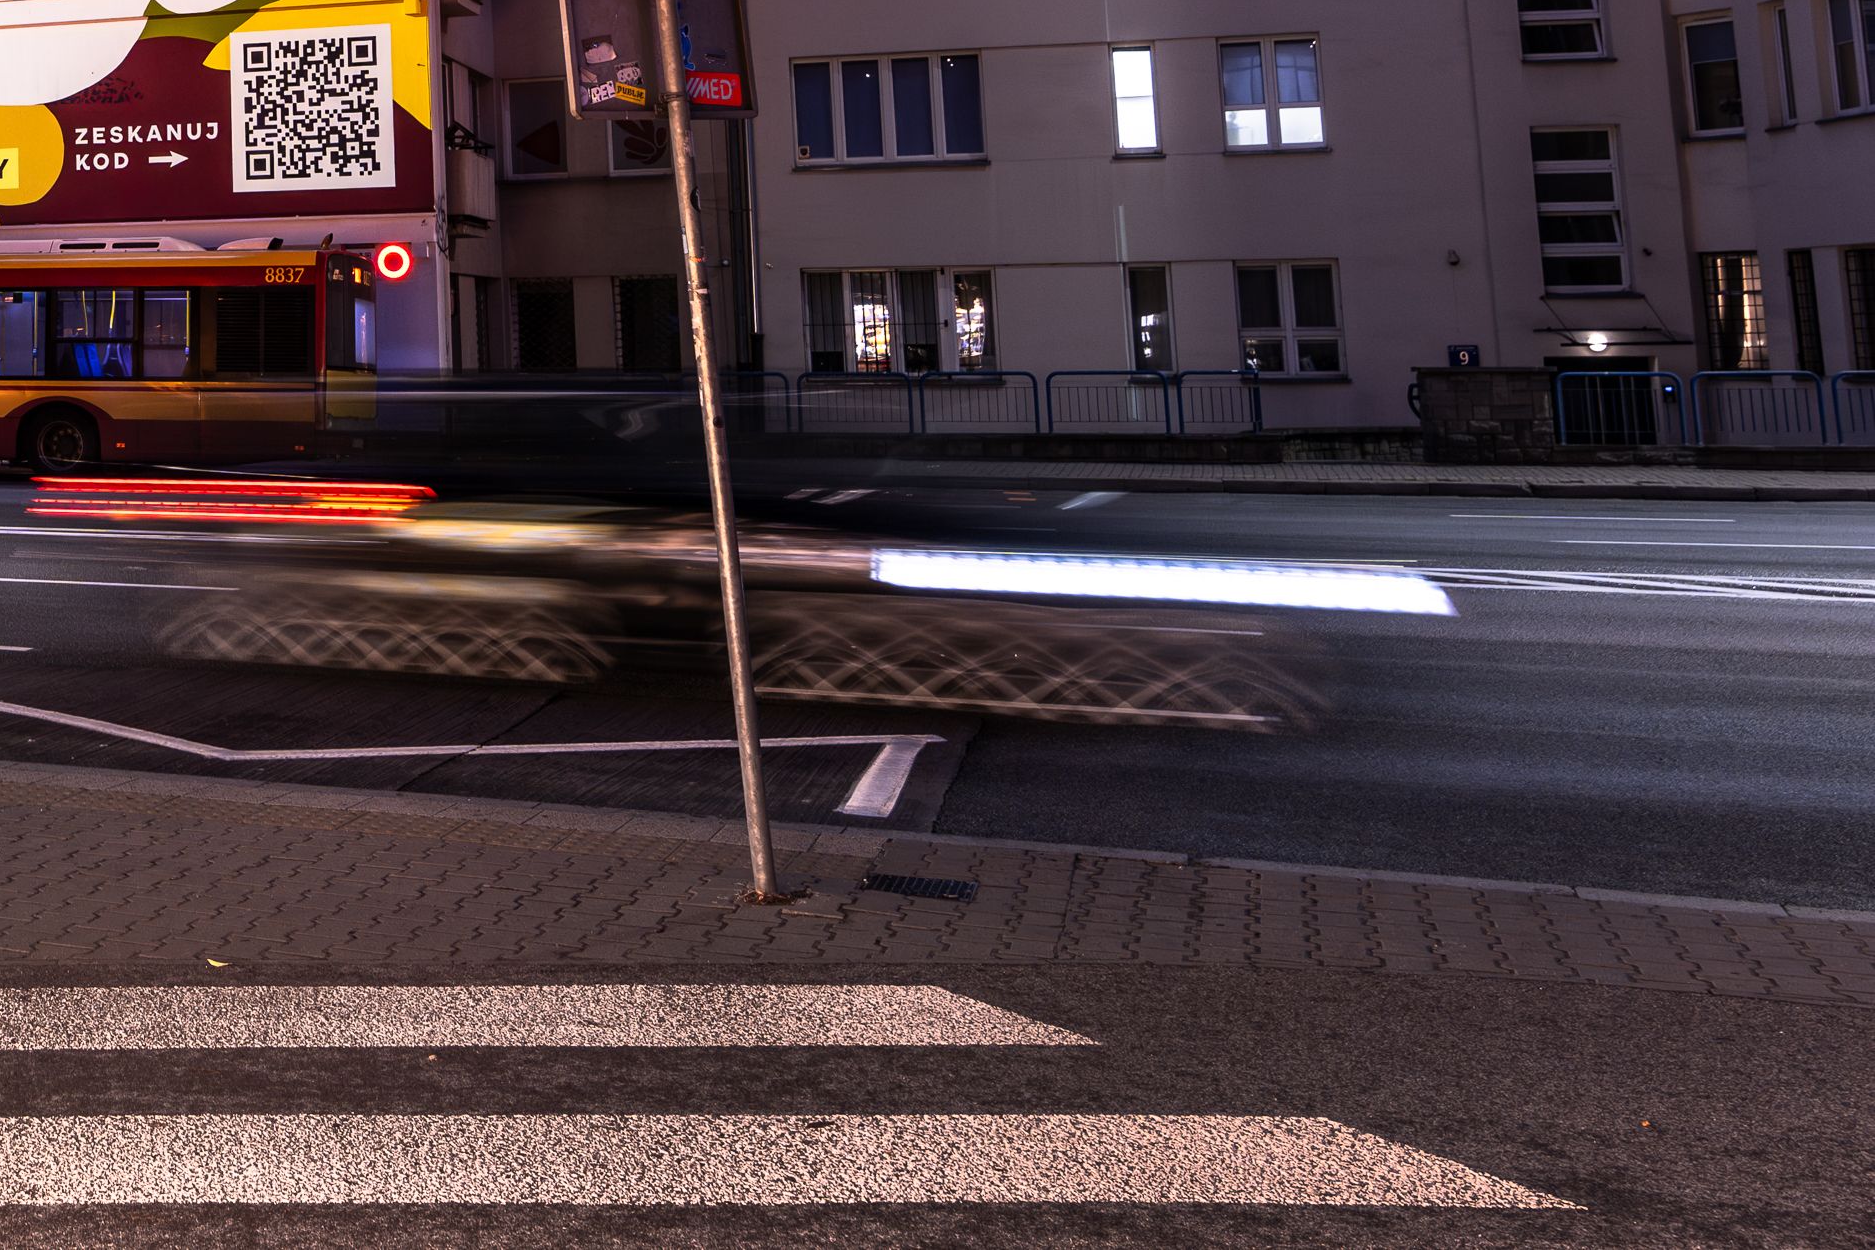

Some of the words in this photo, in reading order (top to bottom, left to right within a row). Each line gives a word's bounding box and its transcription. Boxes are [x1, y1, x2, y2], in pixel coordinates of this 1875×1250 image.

[75, 122, 219, 145] ZESKANUJ
[75, 152, 129, 171] KOD
[265, 267, 305, 283] 8837
[1459, 351, 1469, 366] 9
